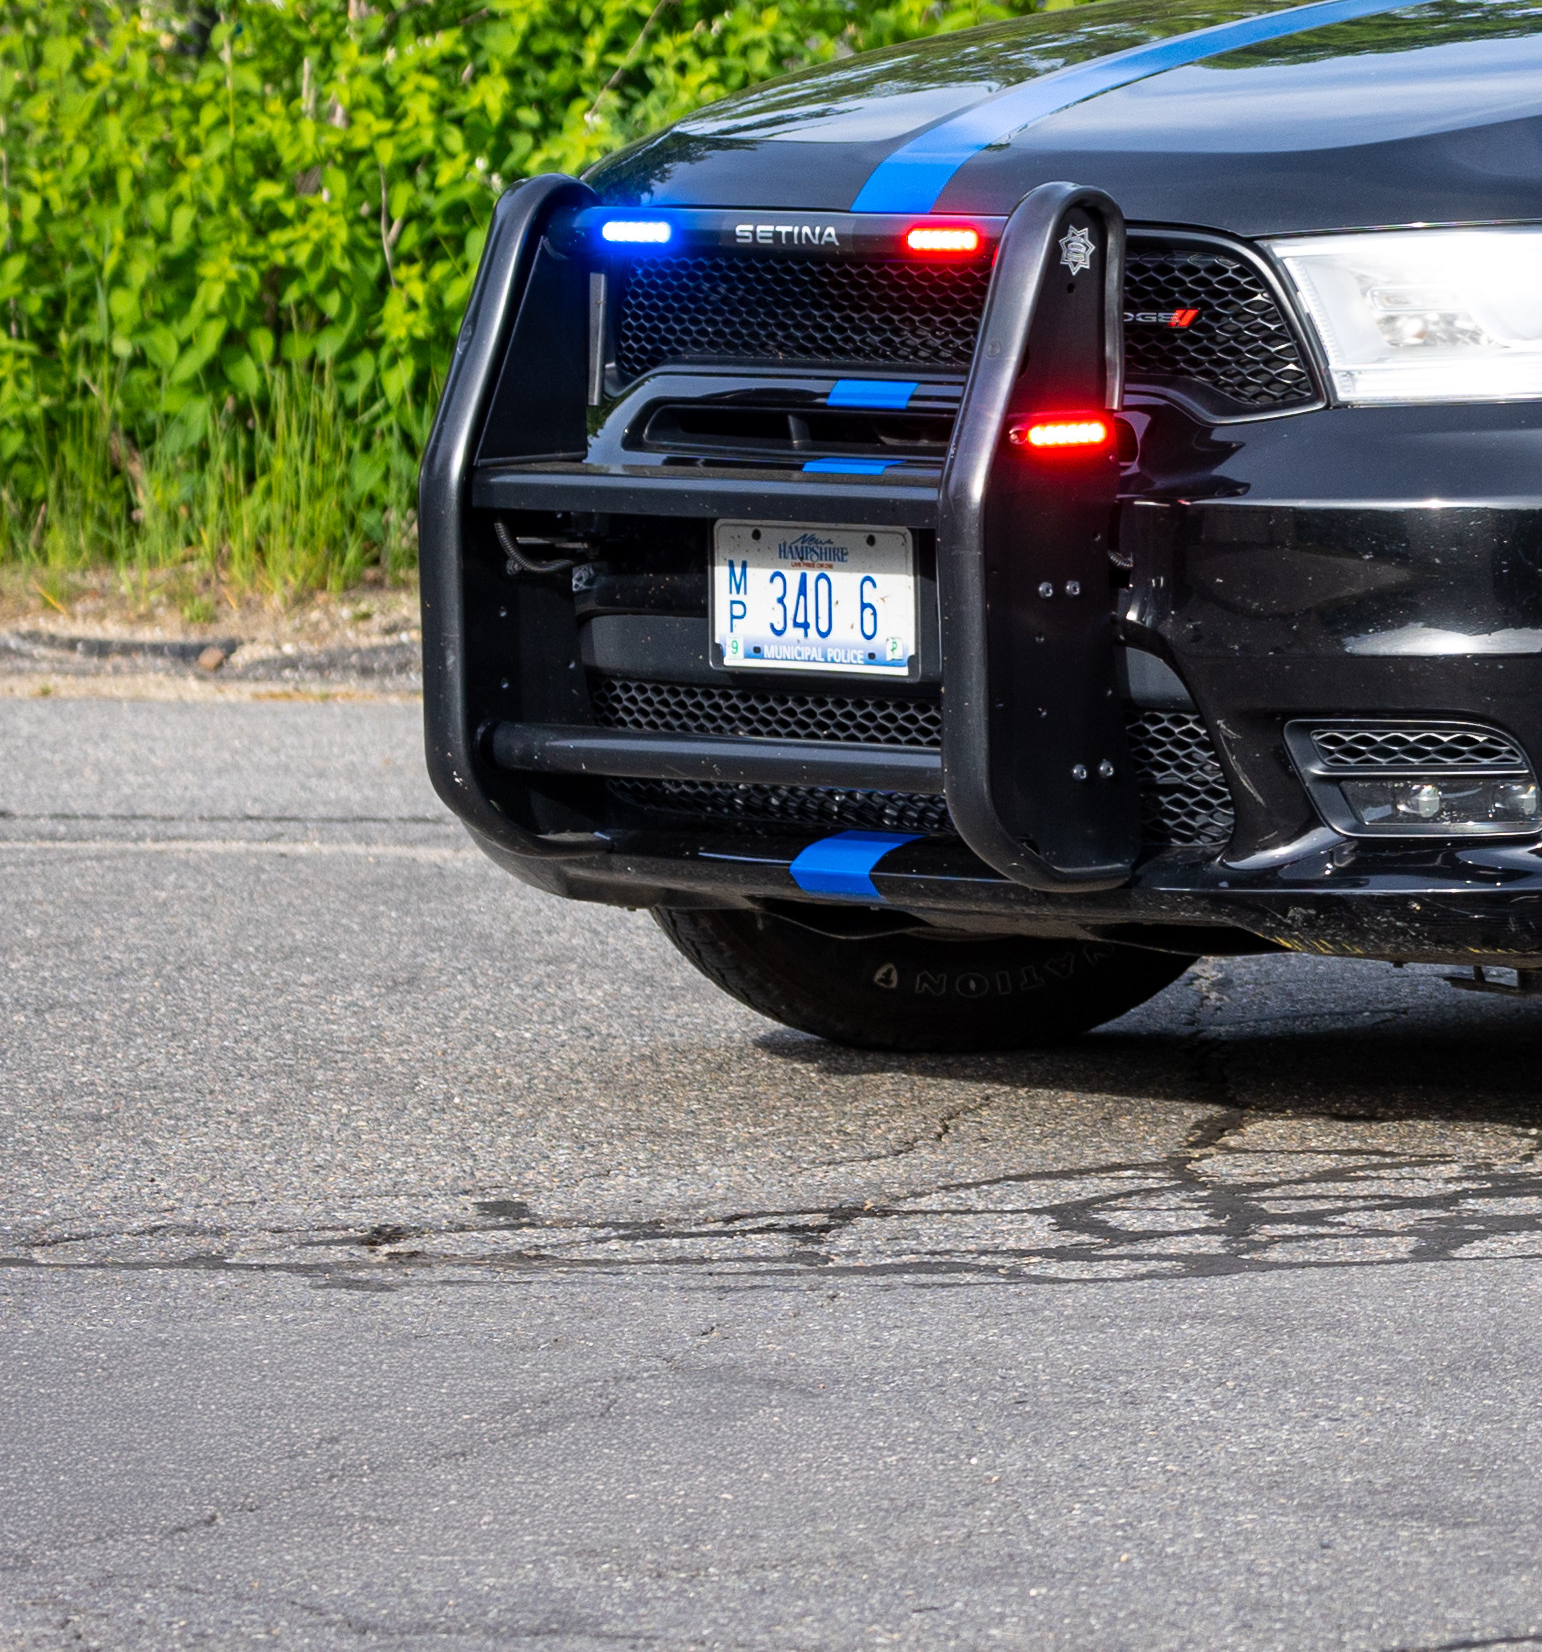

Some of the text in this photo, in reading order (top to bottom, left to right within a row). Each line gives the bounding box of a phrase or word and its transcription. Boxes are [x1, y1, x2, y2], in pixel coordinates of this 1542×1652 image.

[735, 224, 840, 246] SETINA
[791, 532, 835, 546] New
[778, 541, 849, 563] HAMPSHIRE
[769, 571, 878, 641] 340 6
[731, 639, 739, 655] 9
[764, 644, 865, 665] MUNICIPAL POLICE
